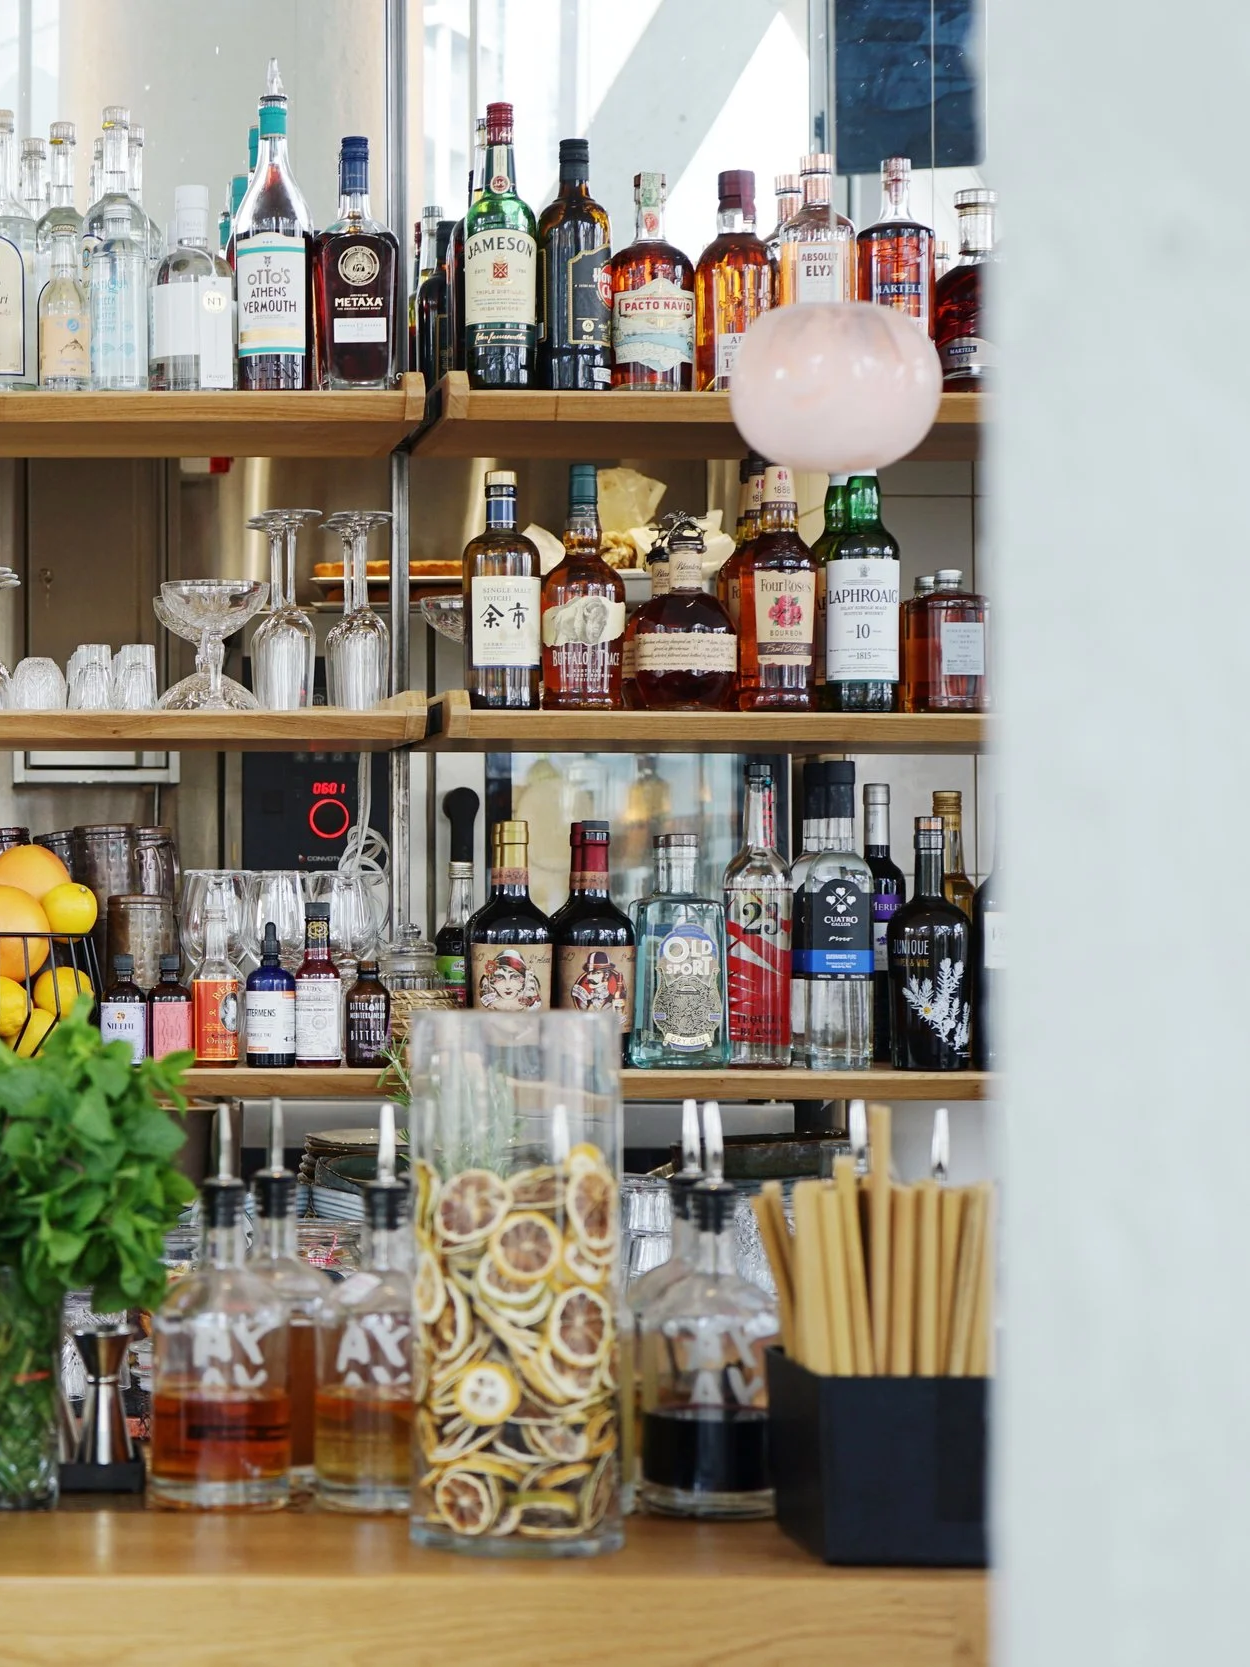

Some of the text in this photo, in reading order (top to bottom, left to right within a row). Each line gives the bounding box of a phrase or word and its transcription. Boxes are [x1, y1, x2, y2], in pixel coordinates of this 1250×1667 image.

[468, 236, 533, 260] JAMESON
[802, 252, 838, 262] ABSOLUT
[806, 265, 834, 276] ELYX
[250, 286, 286, 298] ATHENS
[874, 283, 924, 294] MARTELL
[243, 300, 297, 314] VERMOUTH
[334, 296, 384, 307] METAXA
[624, 300, 691, 312] PACTO NAVIO
[949, 346, 976, 354] MARTELL
[752, 495, 762, 503] 188
[760, 579, 784, 592] Four
[829, 588, 898, 604] LAPHROAIG
[480, 602, 530, 630] 余市
[856, 624, 870, 638] 10
[552, 650, 588, 666] BUFFALO
[598, 650, 620, 666] TRACE
[824, 916, 858, 924] CUATRO
[662, 936, 713, 964] OLD
[894, 939, 930, 956] JUNIQUE
[666, 956, 713, 976] SPORT
[670, 1036, 706, 1044] DRY GIN
